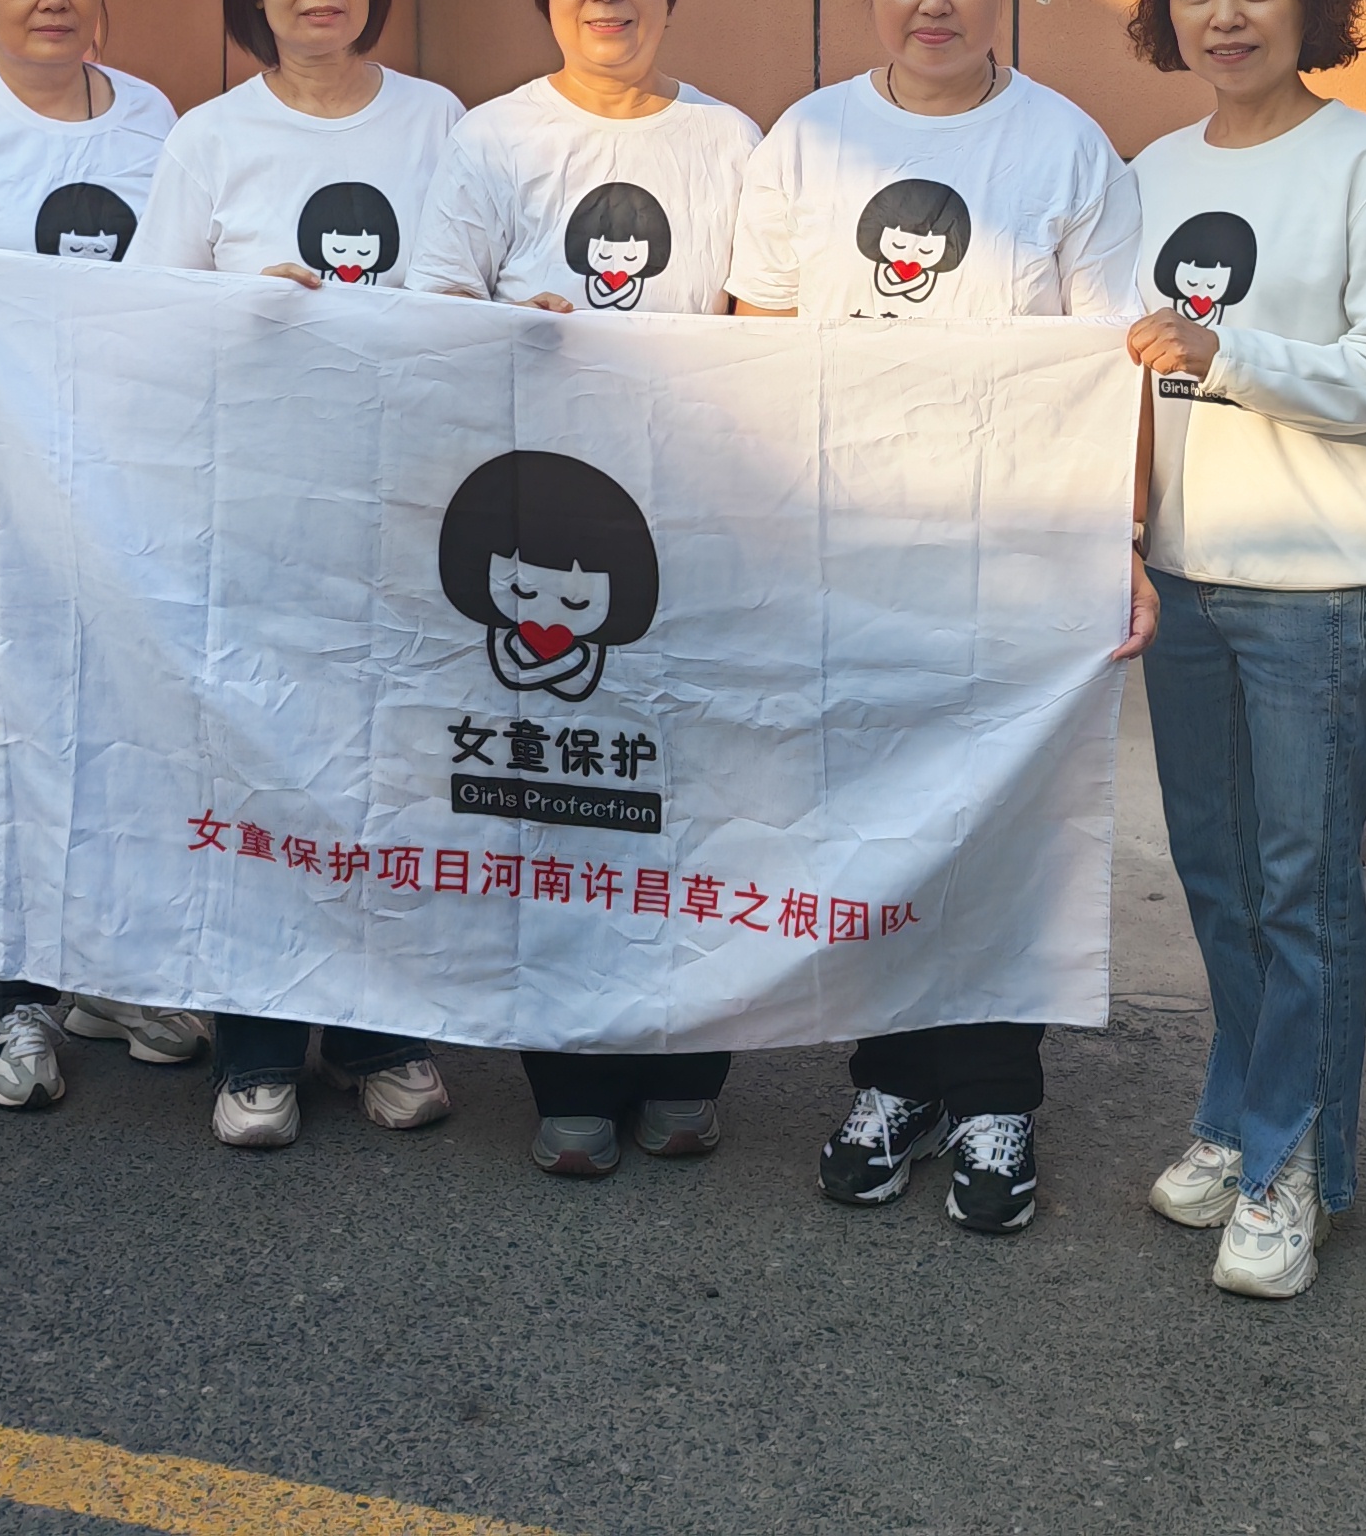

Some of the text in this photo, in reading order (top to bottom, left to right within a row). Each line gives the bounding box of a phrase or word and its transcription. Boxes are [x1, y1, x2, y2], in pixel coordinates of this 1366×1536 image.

[1160, 380, 1190, 395] Girls
[447, 715, 658, 782] 女童保护
[458, 783, 656, 824] Girls Protection
[186, 808, 922, 945] 女童保护项目河南许昌草之根团队
